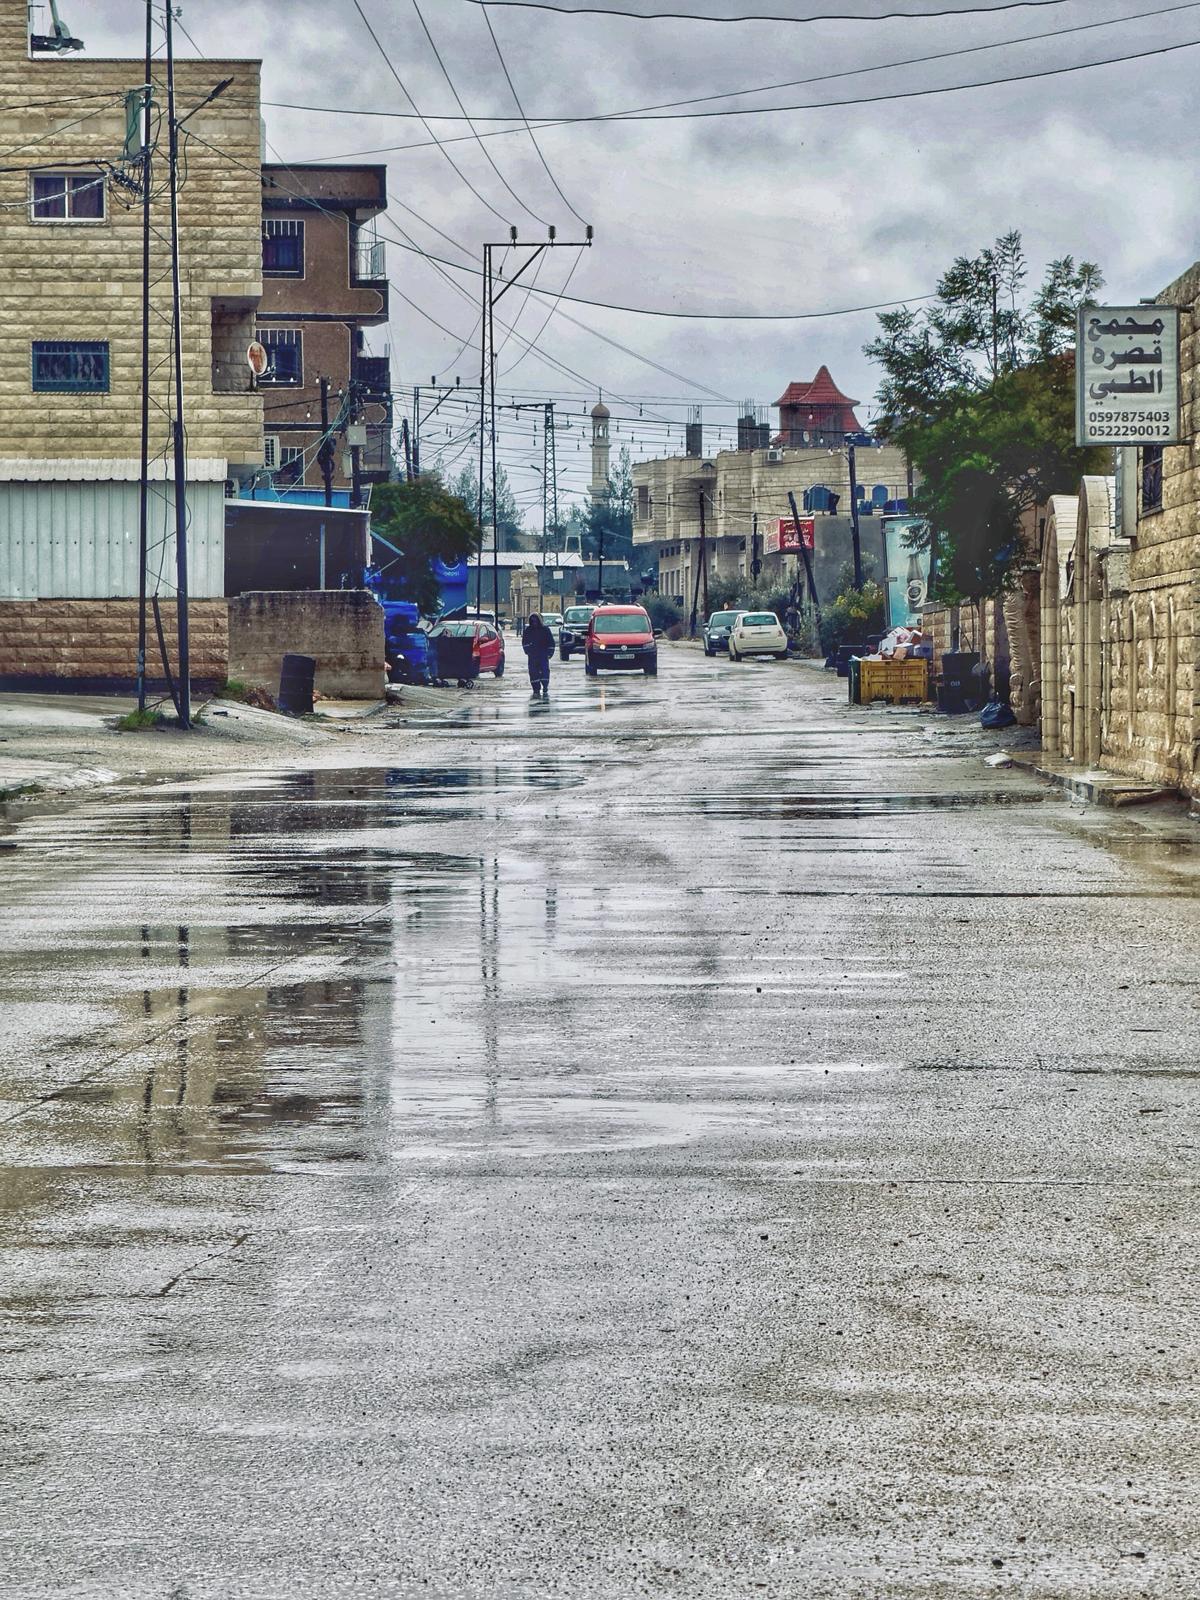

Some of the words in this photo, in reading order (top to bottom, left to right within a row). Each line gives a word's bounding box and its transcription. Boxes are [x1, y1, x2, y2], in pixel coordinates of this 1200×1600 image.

[1088, 317, 1165, 341] مجمع
[1089, 369, 1162, 405] الطبي
[1089, 411, 1170, 423] 0597875403
[1089, 425, 1170, 437] 0522290012
